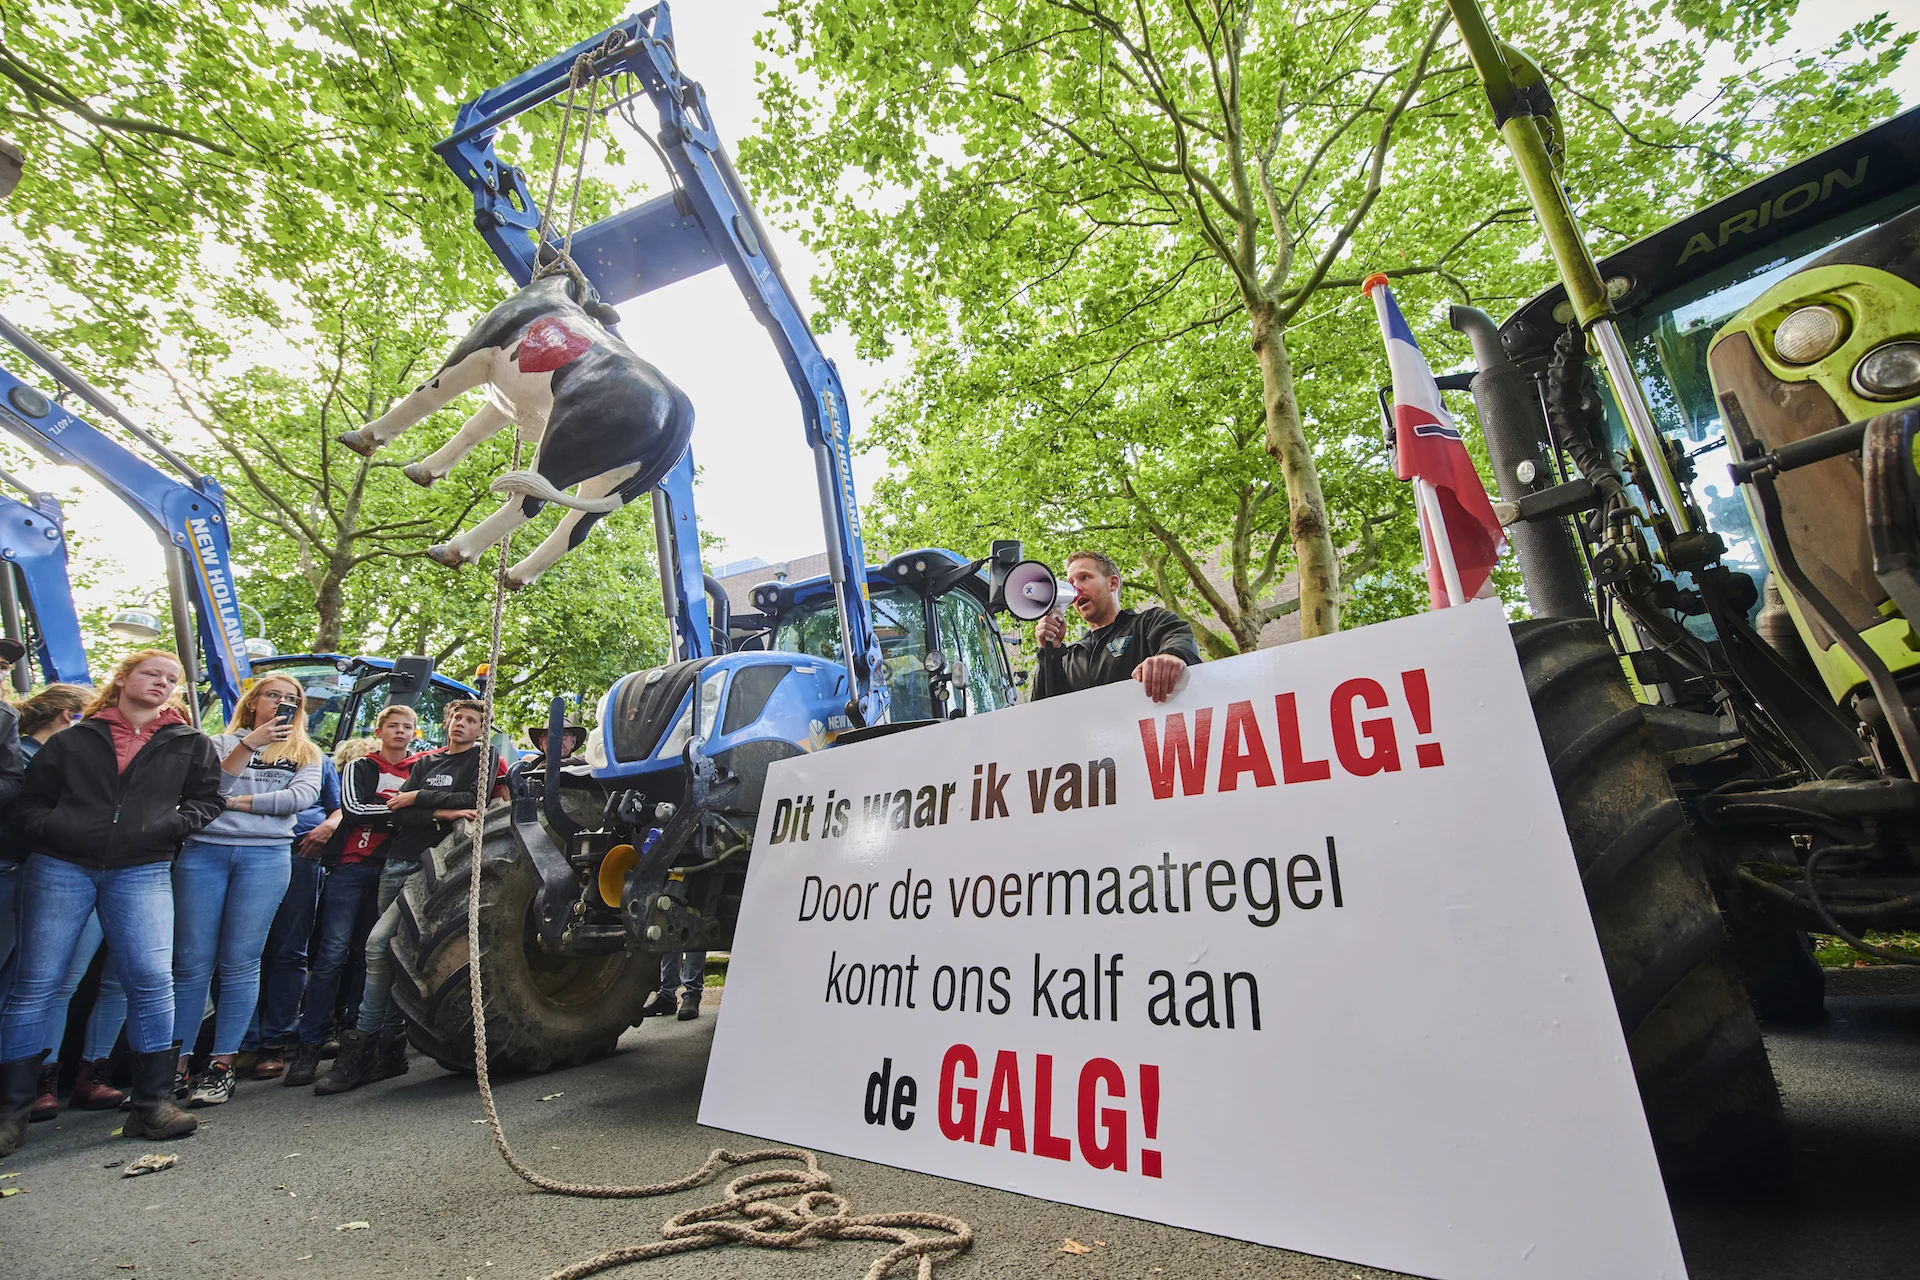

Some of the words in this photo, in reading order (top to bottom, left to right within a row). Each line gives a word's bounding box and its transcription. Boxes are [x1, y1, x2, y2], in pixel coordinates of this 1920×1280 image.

[1675, 155, 1869, 267] ARION
[48, 415, 74, 436] 740TL
[826, 389, 844, 440] NEW
[838, 442, 861, 539] HOLLAND
[190, 518, 220, 566] NEW
[207, 568, 246, 658] HOLLAND
[769, 793, 815, 846] Dit
[821, 789, 851, 839] is
[862, 780, 957, 831] waar
[970, 762, 1012, 822] ik
[1027, 757, 1117, 815] van
[1139, 668, 1445, 800] WALG!
[827, 714, 848, 731] NEW
[798, 874, 880, 923] Door
[888, 867, 933, 921] de
[948, 836, 1345, 928] voermaatregel
[825, 951, 919, 1010] komt
[932, 964, 1012, 1016] ons
[1032, 953, 1125, 1023] kalf
[1147, 968, 1263, 1033] aan
[864, 1057, 918, 1132] de
[938, 1043, 1164, 1180] GALG!
